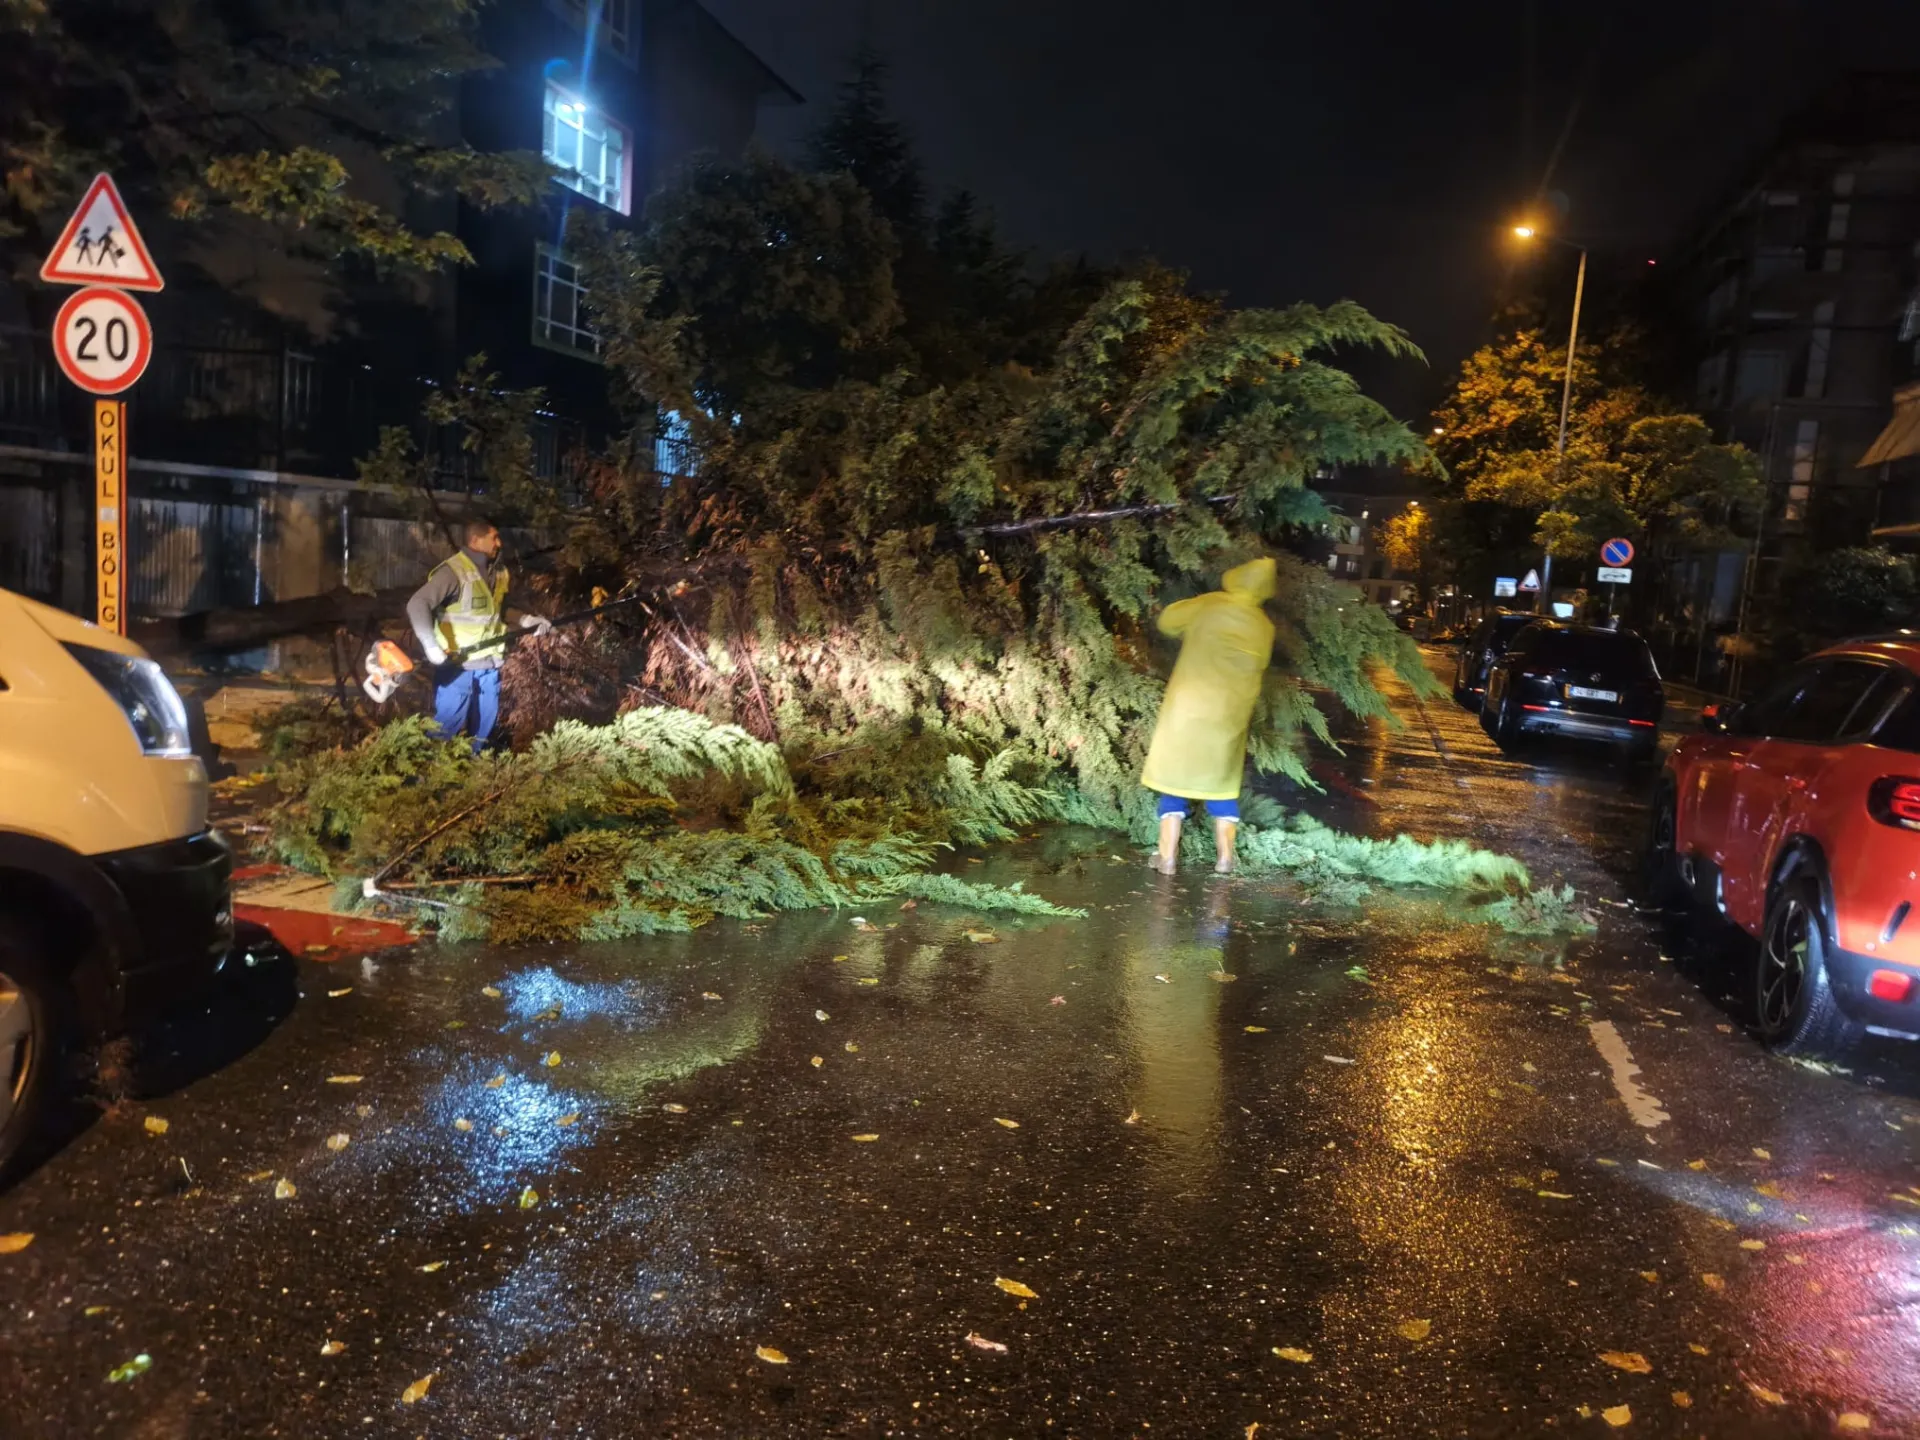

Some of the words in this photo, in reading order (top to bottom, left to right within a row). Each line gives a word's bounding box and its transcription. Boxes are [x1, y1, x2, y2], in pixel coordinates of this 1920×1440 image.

[75, 317, 129, 362] 20
[100, 410, 115, 498] OKUL
[101, 532, 116, 633] BÖLG
